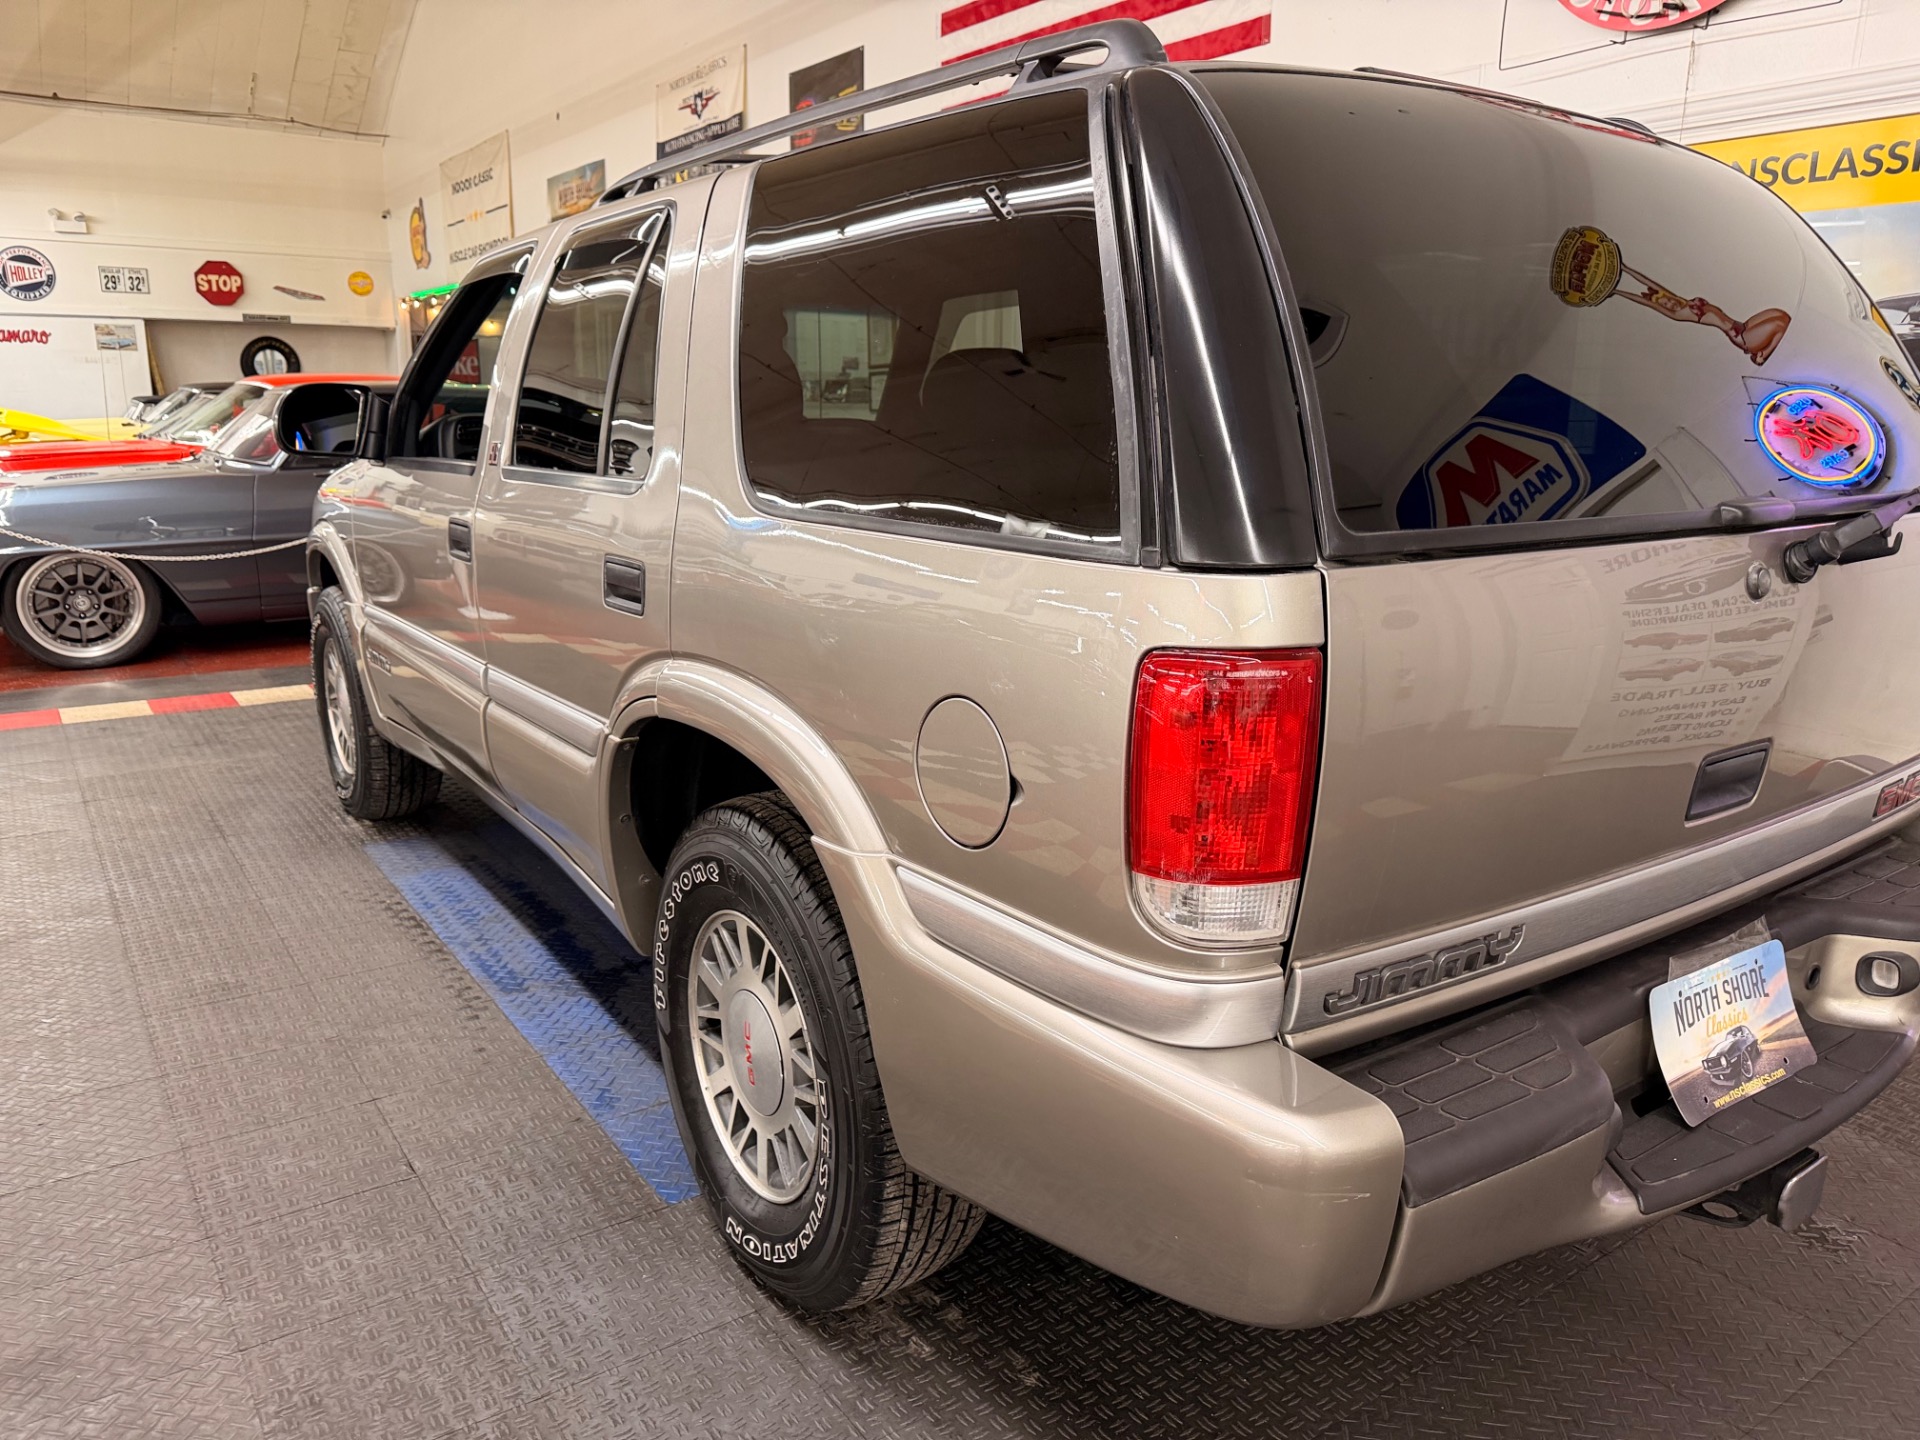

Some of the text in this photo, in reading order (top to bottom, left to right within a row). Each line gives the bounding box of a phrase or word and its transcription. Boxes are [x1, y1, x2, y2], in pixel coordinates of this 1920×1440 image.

[9, 264, 43, 283] HOLLEY
[197, 274, 242, 293] STOP
[0, 329, 51, 344] amaro
[654, 861, 720, 1010] Firestone
[1673, 964, 1770, 1037] NORTH SHORE
[1705, 1007, 1749, 1038] Classics
[742, 1020, 756, 1086] GMC
[1713, 1067, 1786, 1109] www.nsclassics.com
[725, 1078, 831, 1263] DESTINATION
